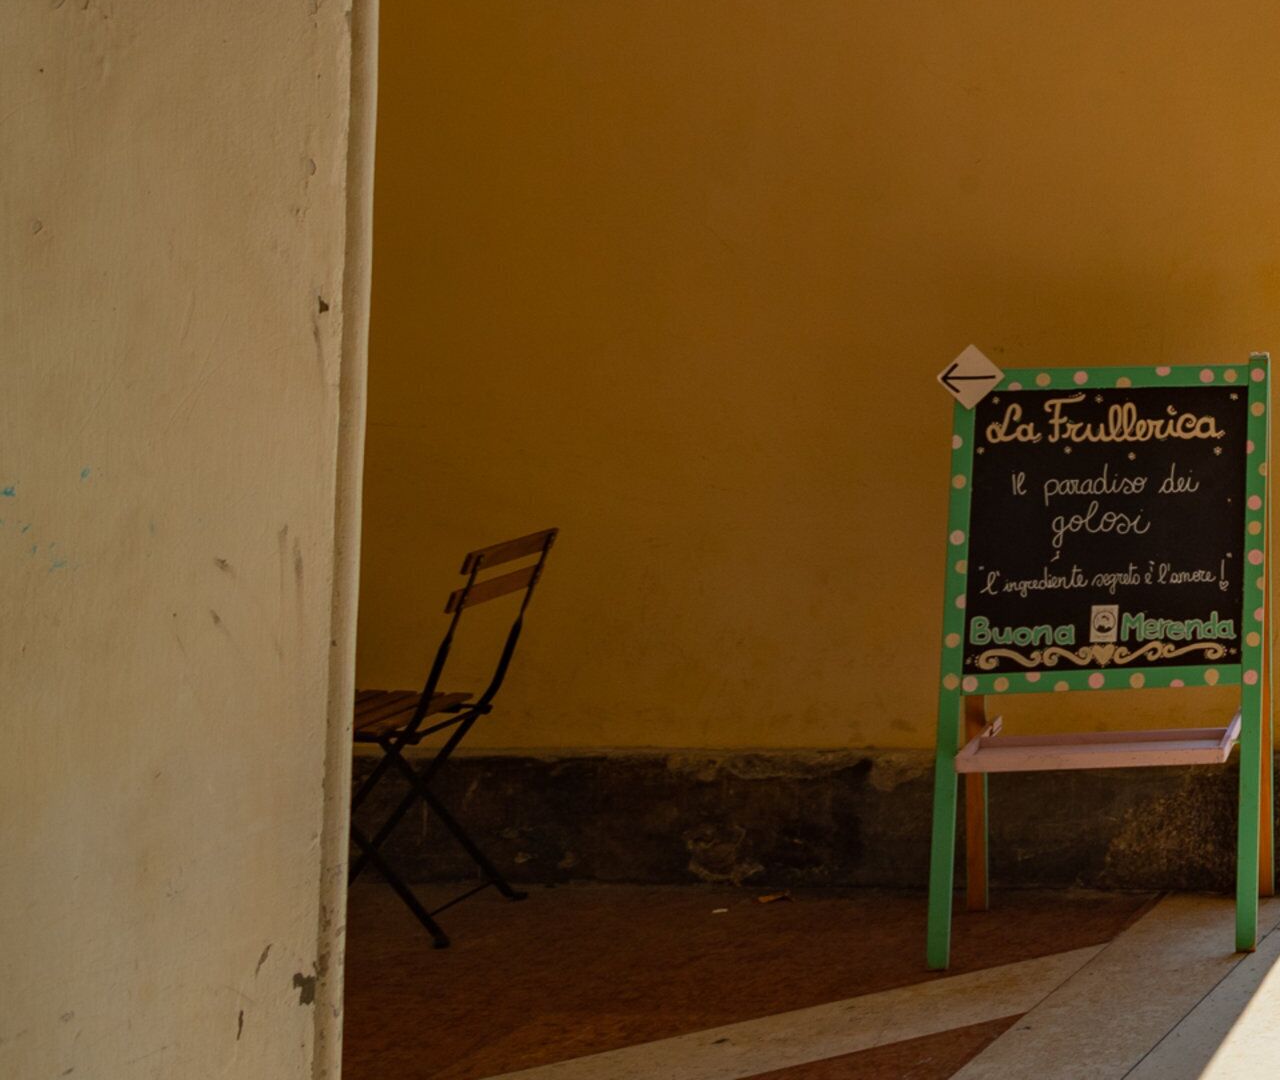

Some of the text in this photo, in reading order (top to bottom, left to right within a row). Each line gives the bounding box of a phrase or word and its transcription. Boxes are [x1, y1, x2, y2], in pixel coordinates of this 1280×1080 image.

[986, 393, 1226, 443] La Frullerica
[1044, 463, 1147, 507] paradiso
[1158, 462, 1199, 494] dei
[1052, 500, 1150, 548] golosi
[1091, 562, 1140, 595] segreto
[970, 610, 1237, 646] Buona Merenda
